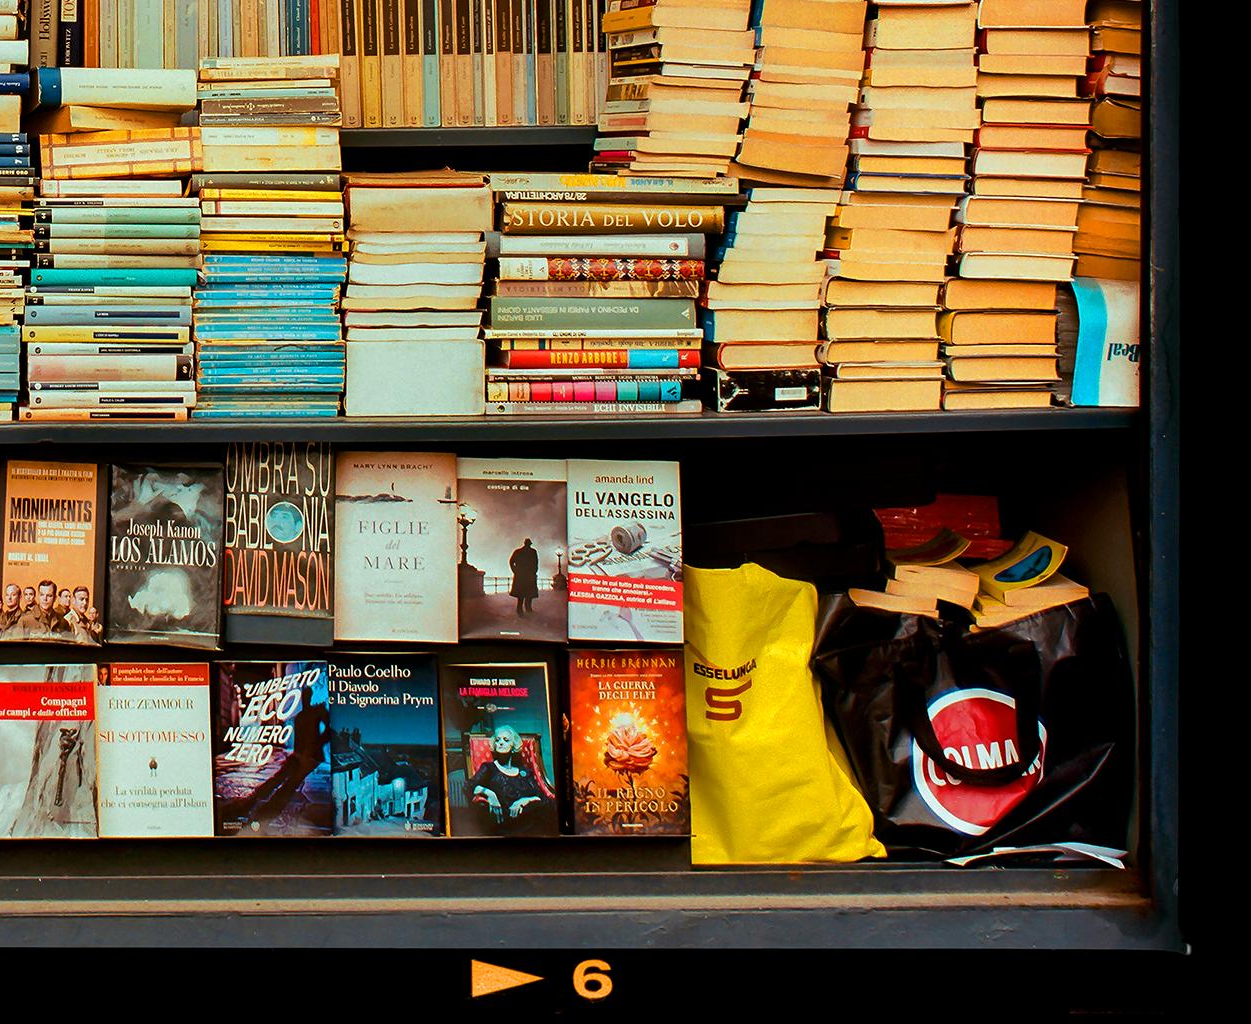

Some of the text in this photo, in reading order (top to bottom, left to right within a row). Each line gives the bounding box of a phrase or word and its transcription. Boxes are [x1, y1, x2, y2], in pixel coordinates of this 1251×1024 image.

[505, 191, 564, 200] ARCHITETTURA
[513, 209, 703, 227] STORIA DEL VOLO
[550, 351, 618, 365] RENZO ARBORE
[593, 403, 666, 412] ECHI INVISIBILI
[226, 441, 331, 496] OMBRA SU
[353, 463, 433, 471] MARY LYNN BRACHT
[594, 474, 654, 485] amanda lind
[575, 491, 675, 508] IL VANGELO
[10, 497, 92, 522] MONUMENTS
[575, 508, 676, 521] DELL'ASSASSINA
[9, 521, 37, 544] MEN
[126, 517, 201, 539] Joseph Kanon
[358, 519, 430, 536] FIGLIE
[110, 535, 216, 567] LOS ALAMOS
[385, 540, 400, 551] del
[363, 556, 426, 571] MARE
[225, 548, 330, 611] DAVID MASON
[576, 657, 676, 670] HERBIE BRENNAN
[693, 658, 757, 680] ESSELUNGA
[328, 664, 411, 678] Paulo Coelho
[245, 667, 322, 698] UMBERTO
[337, 680, 379, 693] Diavolo
[598, 681, 656, 691] LA GUERRA
[40, 696, 88, 708] Compagni
[336, 693, 347, 705] la
[349, 693, 400, 709] Signorina
[402, 694, 434, 709] Prym
[599, 691, 656, 701] DEGLI ELFI
[137, 698, 194, 710] ZEMMOUR
[242, 688, 302, 723] ECO
[6, 707, 88, 718] campi officine
[119, 730, 206, 744] SOTTOMESSO
[222, 724, 293, 745] NUMERO
[224, 743, 274, 765] ZERO
[927, 738, 1041, 787] COLMA
[160, 785, 193, 799] perduta
[597, 787, 666, 800] IL REGNO
[129, 798, 208, 811] consegna all'Islam
[585, 800, 679, 814] IN PERICOLO
